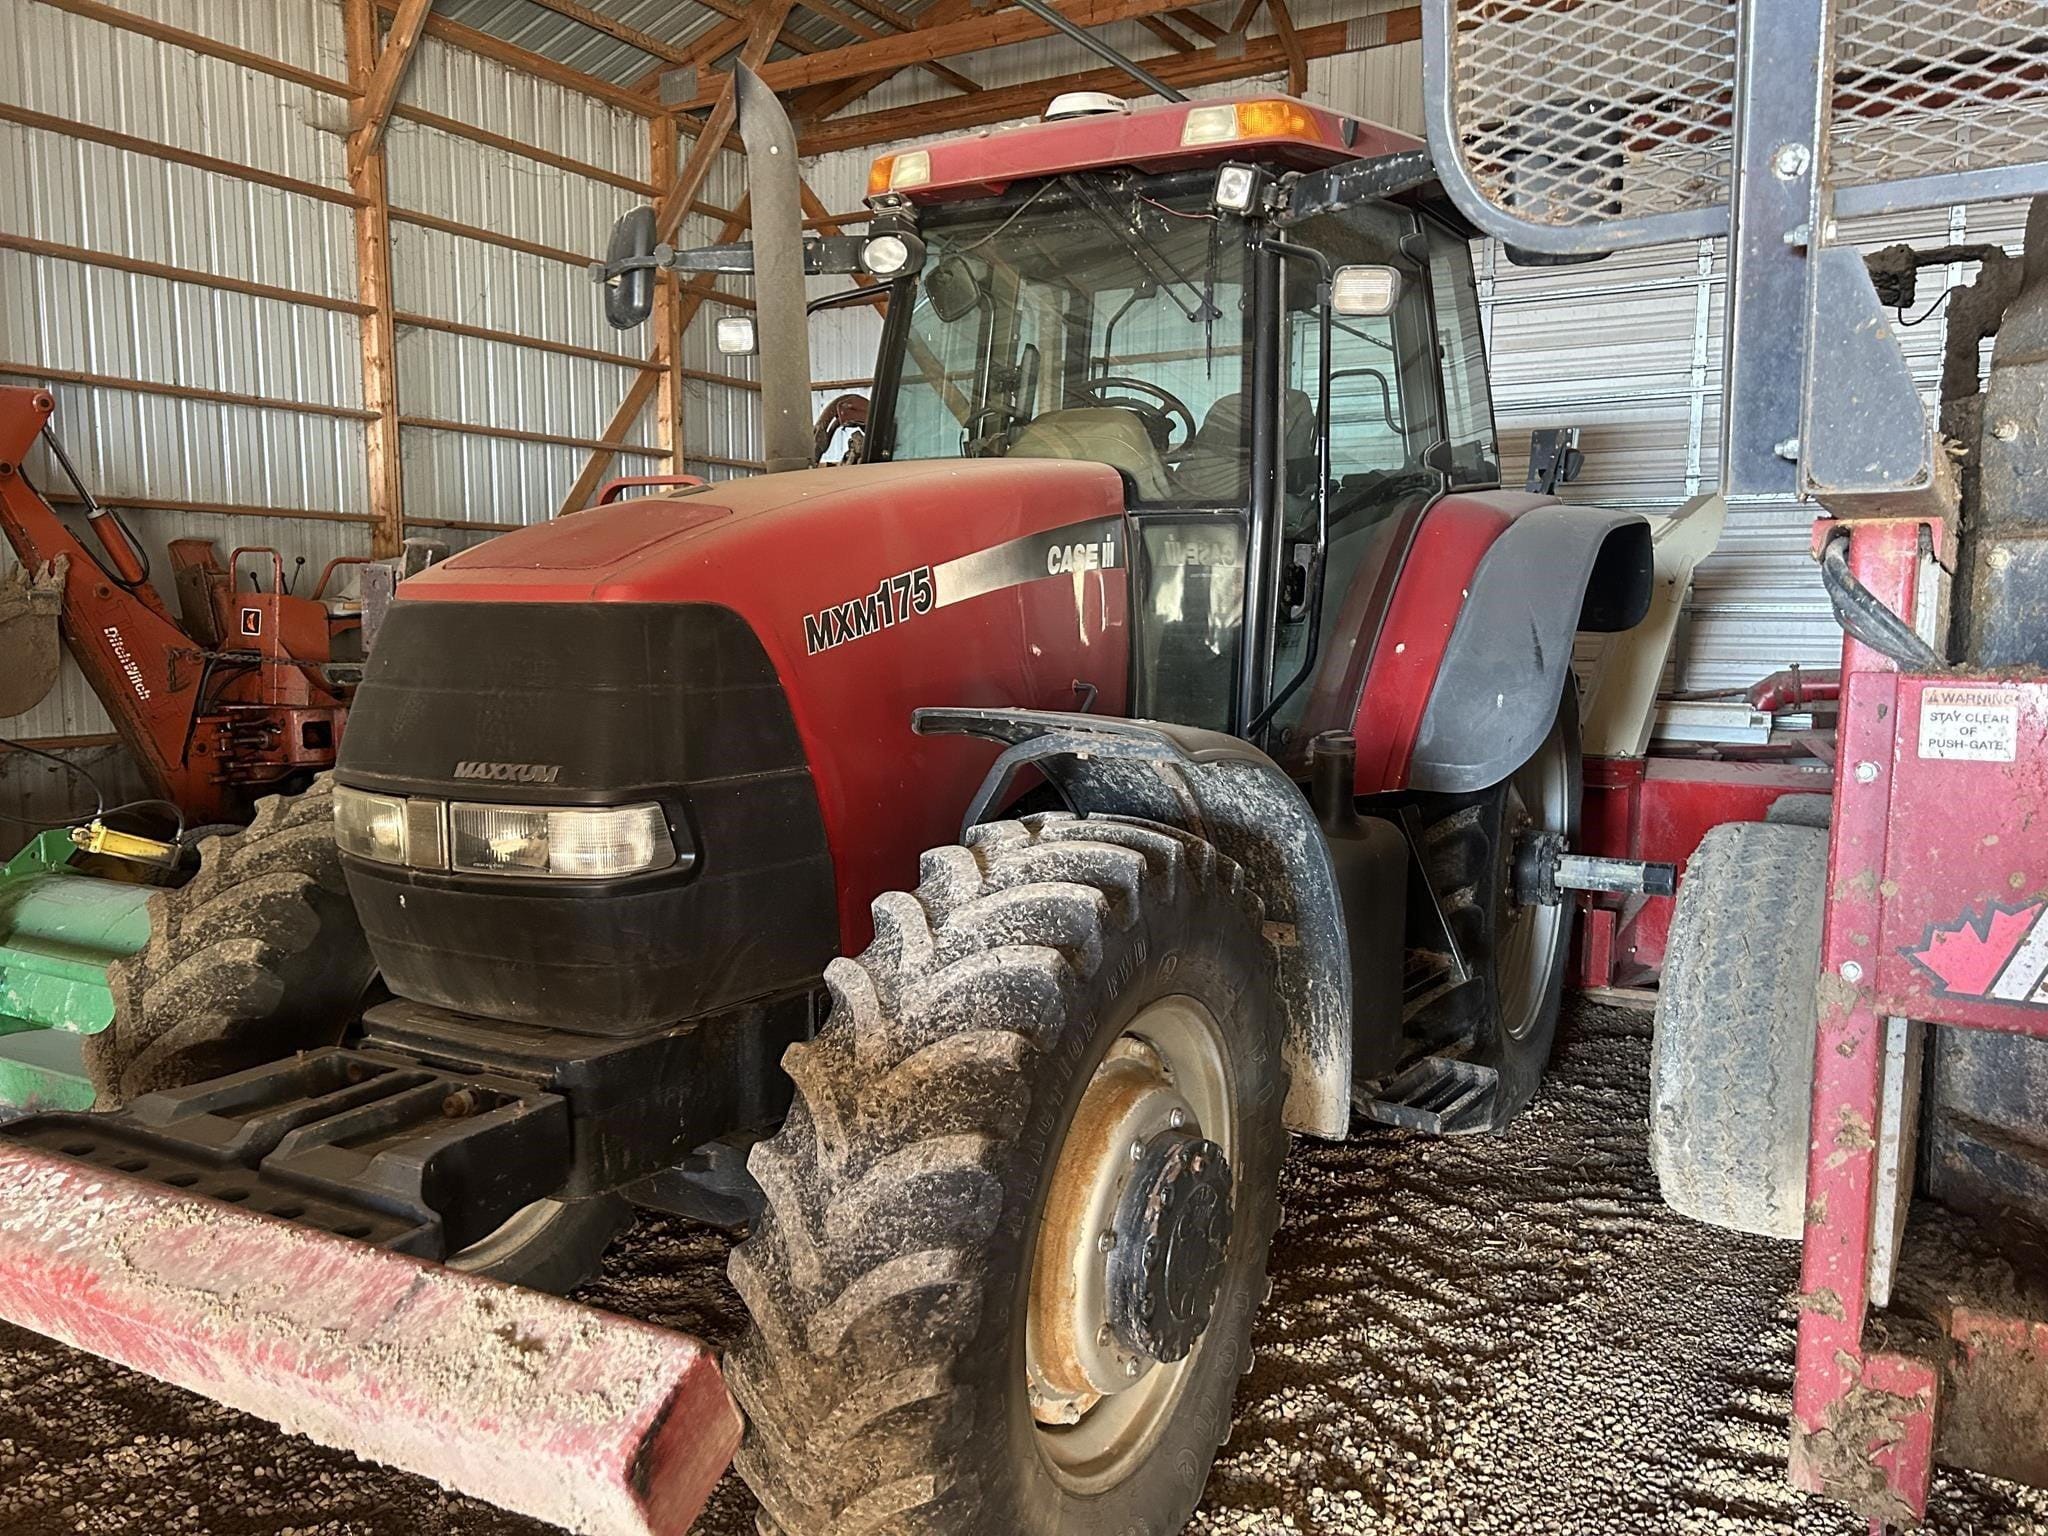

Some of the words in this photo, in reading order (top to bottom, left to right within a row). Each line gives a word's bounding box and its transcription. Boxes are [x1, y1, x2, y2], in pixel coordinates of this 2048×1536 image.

[1047, 543, 1098, 575] CASE
[803, 565, 933, 656] MXM175
[103, 626, 132, 664] Ditch
[123, 661, 152, 700] Witch
[1941, 692, 2013, 706] WARNING
[1930, 711, 1961, 724] STAY
[1965, 713, 2009, 724] CLEAR
[1960, 726, 1977, 737] OF
[453, 761, 564, 783] MAXXUM
